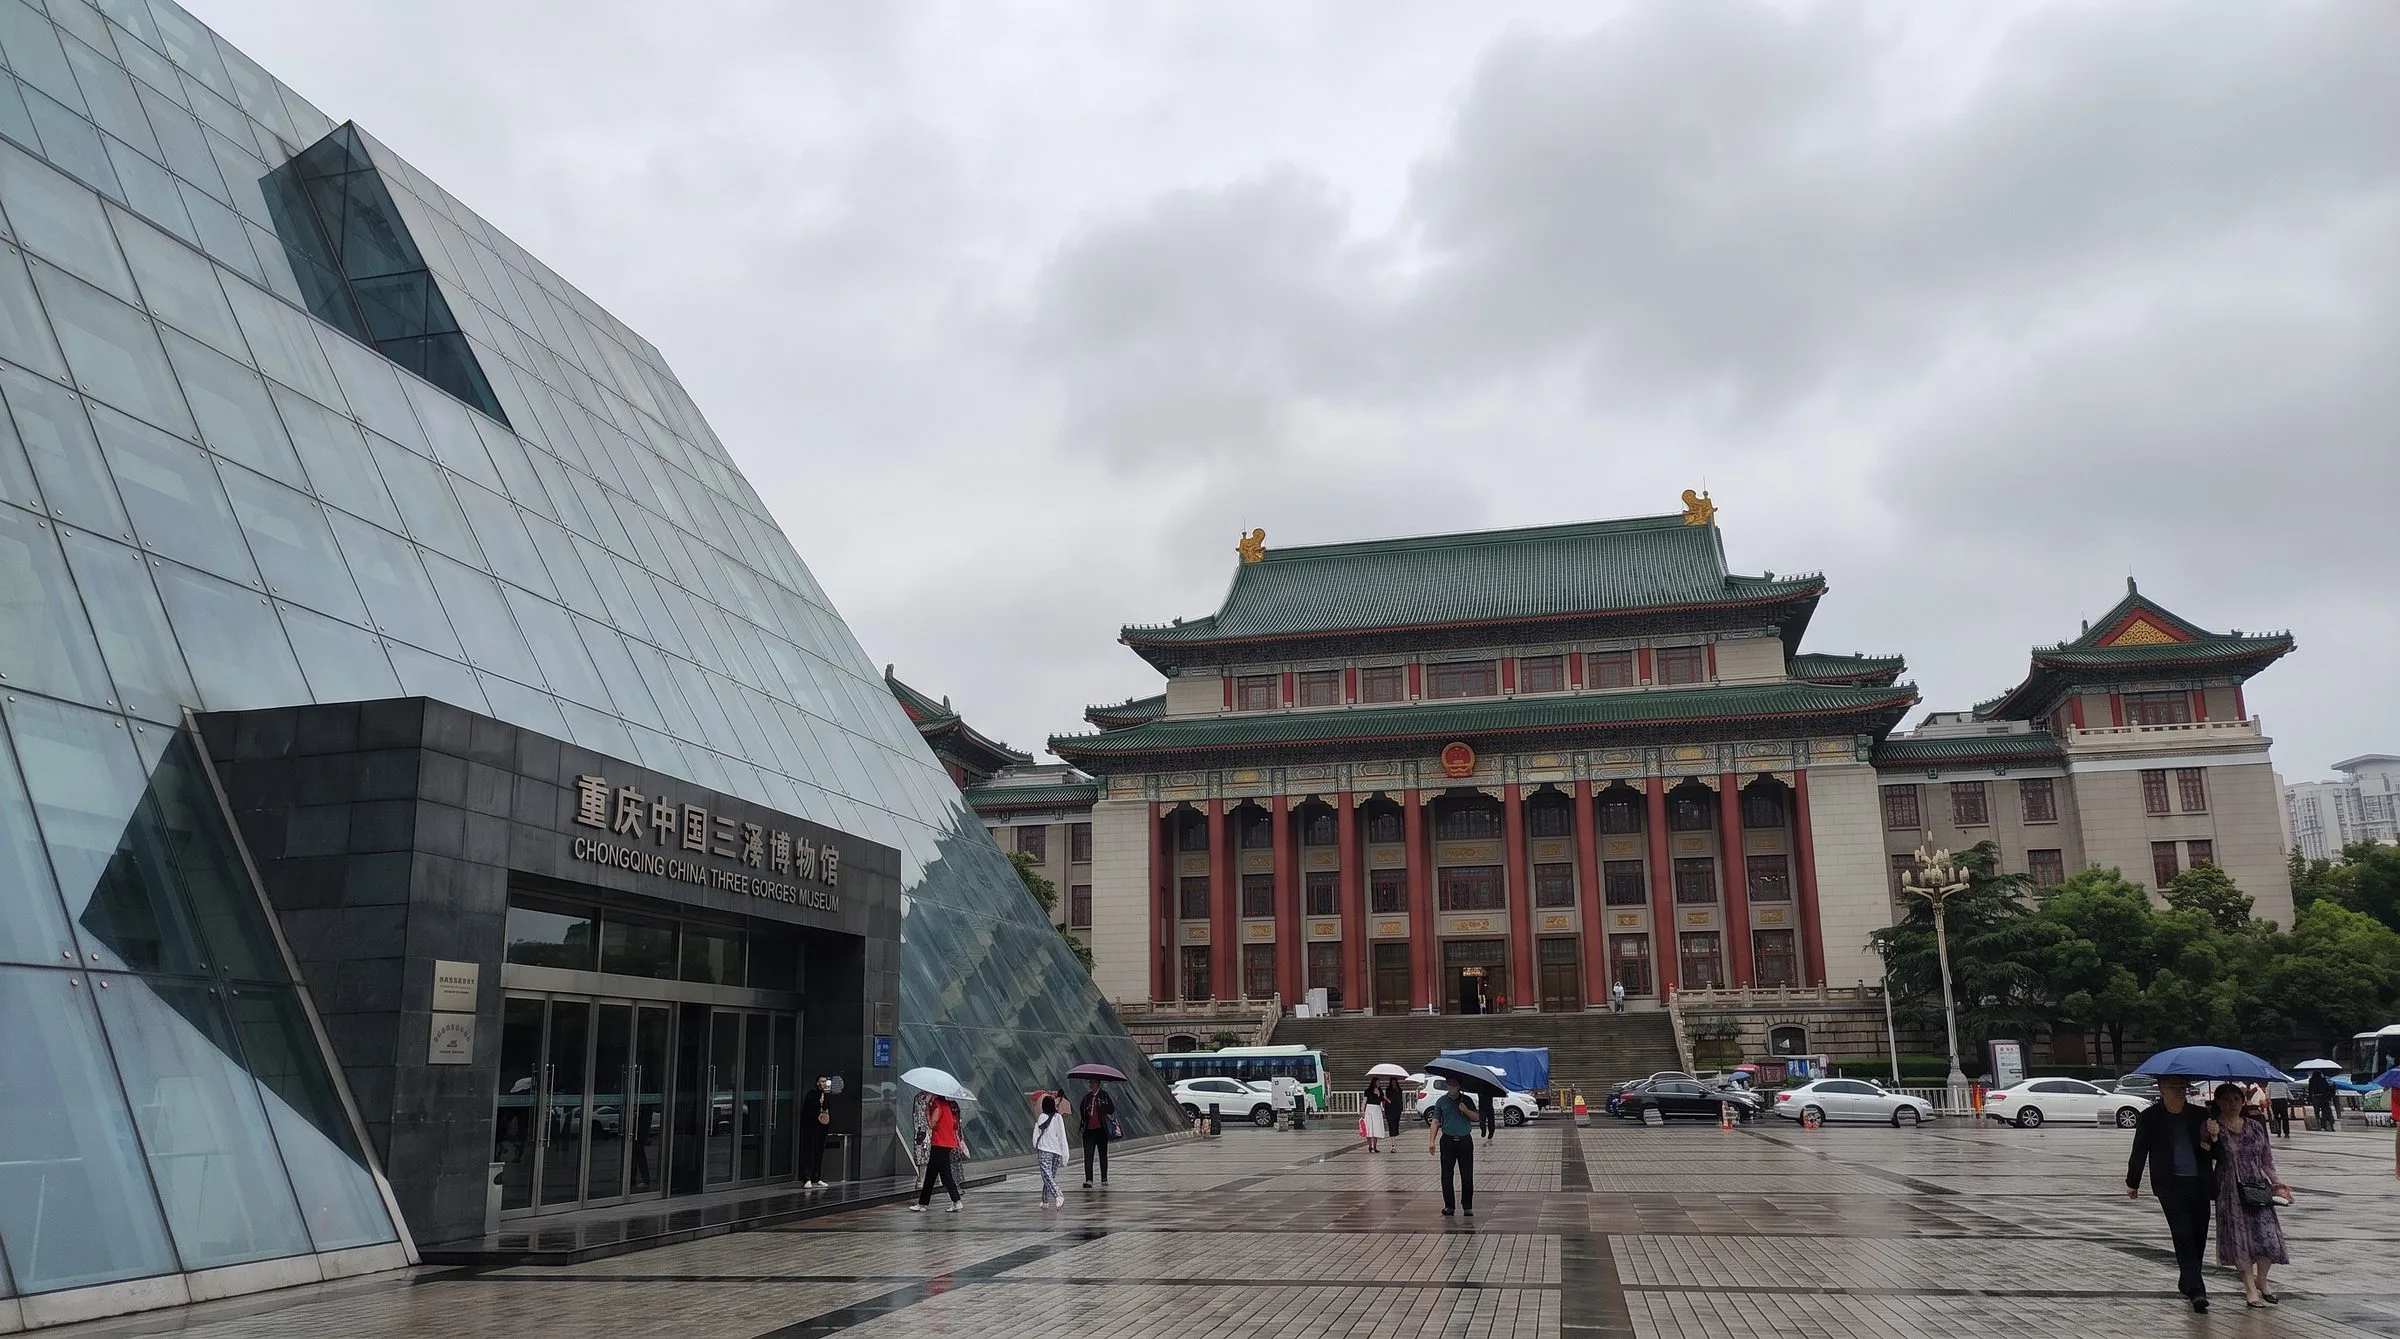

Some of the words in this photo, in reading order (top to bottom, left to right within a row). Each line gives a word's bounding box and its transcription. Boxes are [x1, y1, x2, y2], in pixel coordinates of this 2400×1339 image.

[575, 837, 664, 876] CHONGQING
[668, 859, 707, 885] CHINA
[711, 868, 748, 895] THREE
[751, 879, 796, 905] GORGES
[799, 888, 839, 913] MUSEUM
